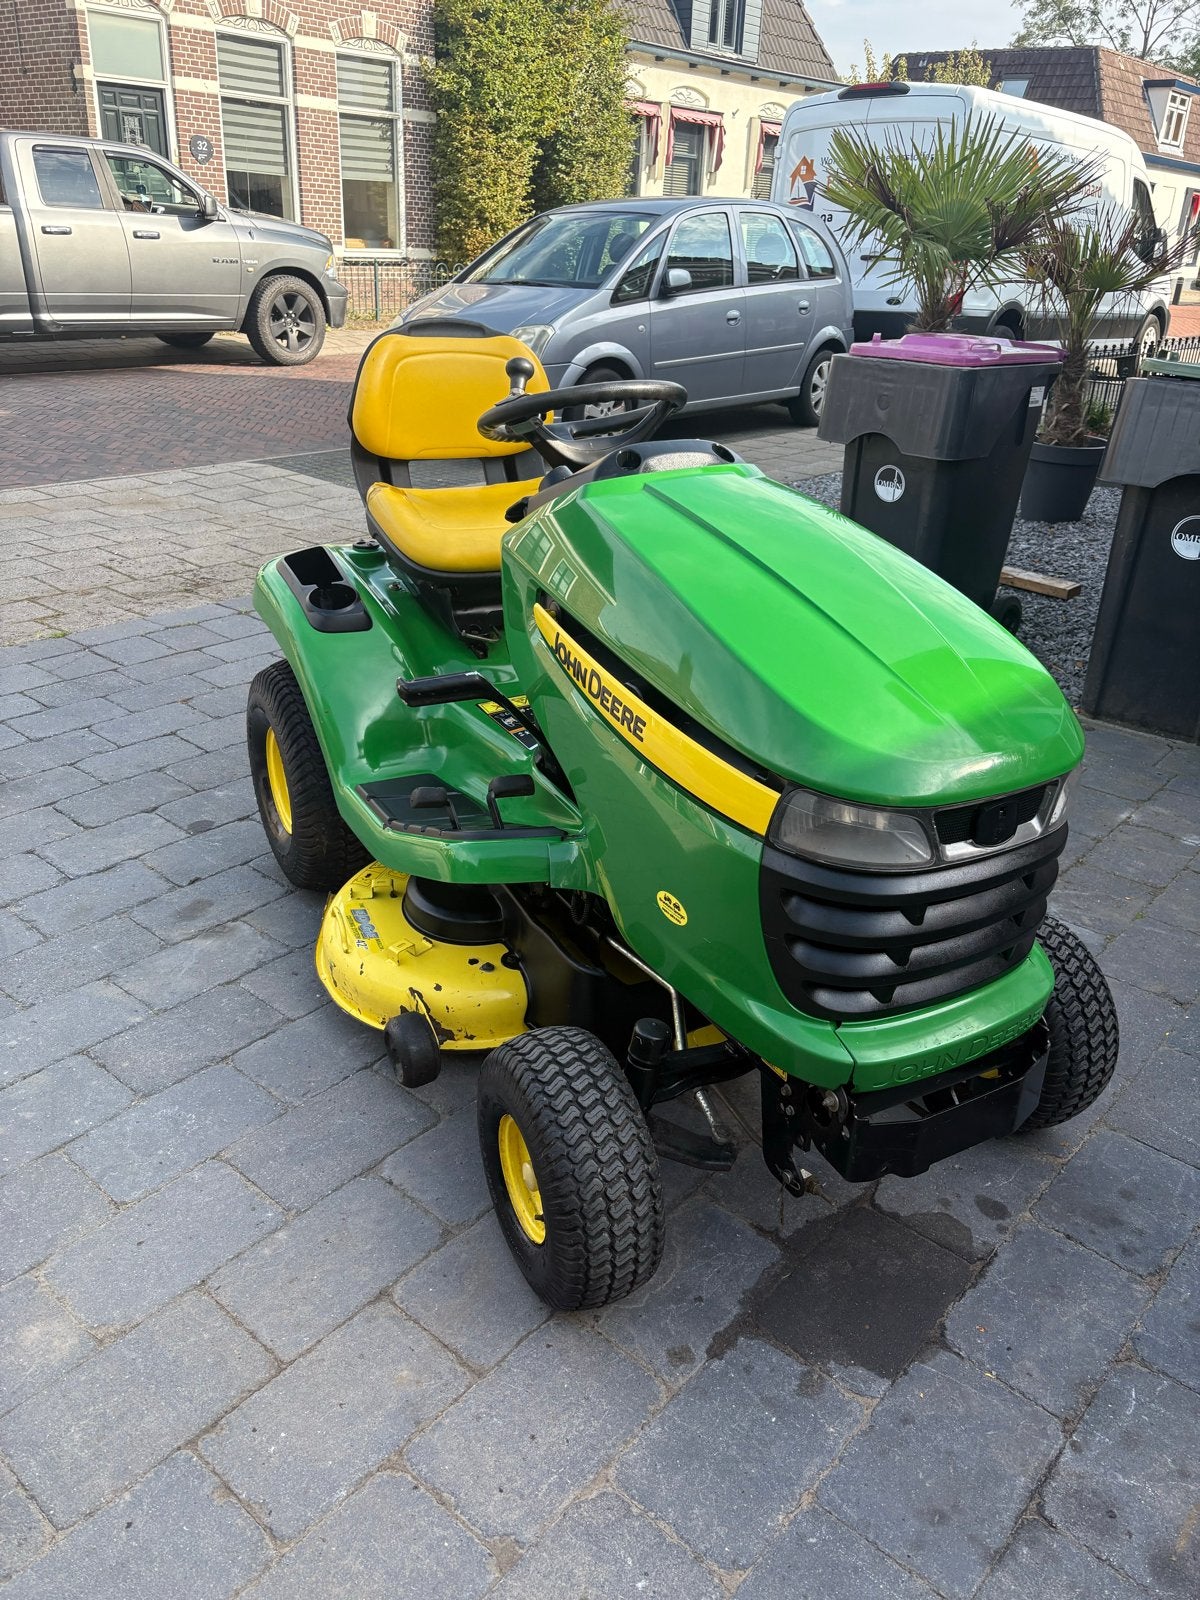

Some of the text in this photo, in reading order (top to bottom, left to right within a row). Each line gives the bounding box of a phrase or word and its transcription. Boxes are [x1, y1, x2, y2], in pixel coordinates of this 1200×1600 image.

[196, 140, 208, 151] 32
[211, 256, 239, 264] RAM
[551, 631, 647, 743] JOHN DEERE
[873, 1046, 962, 1088] JOHN
